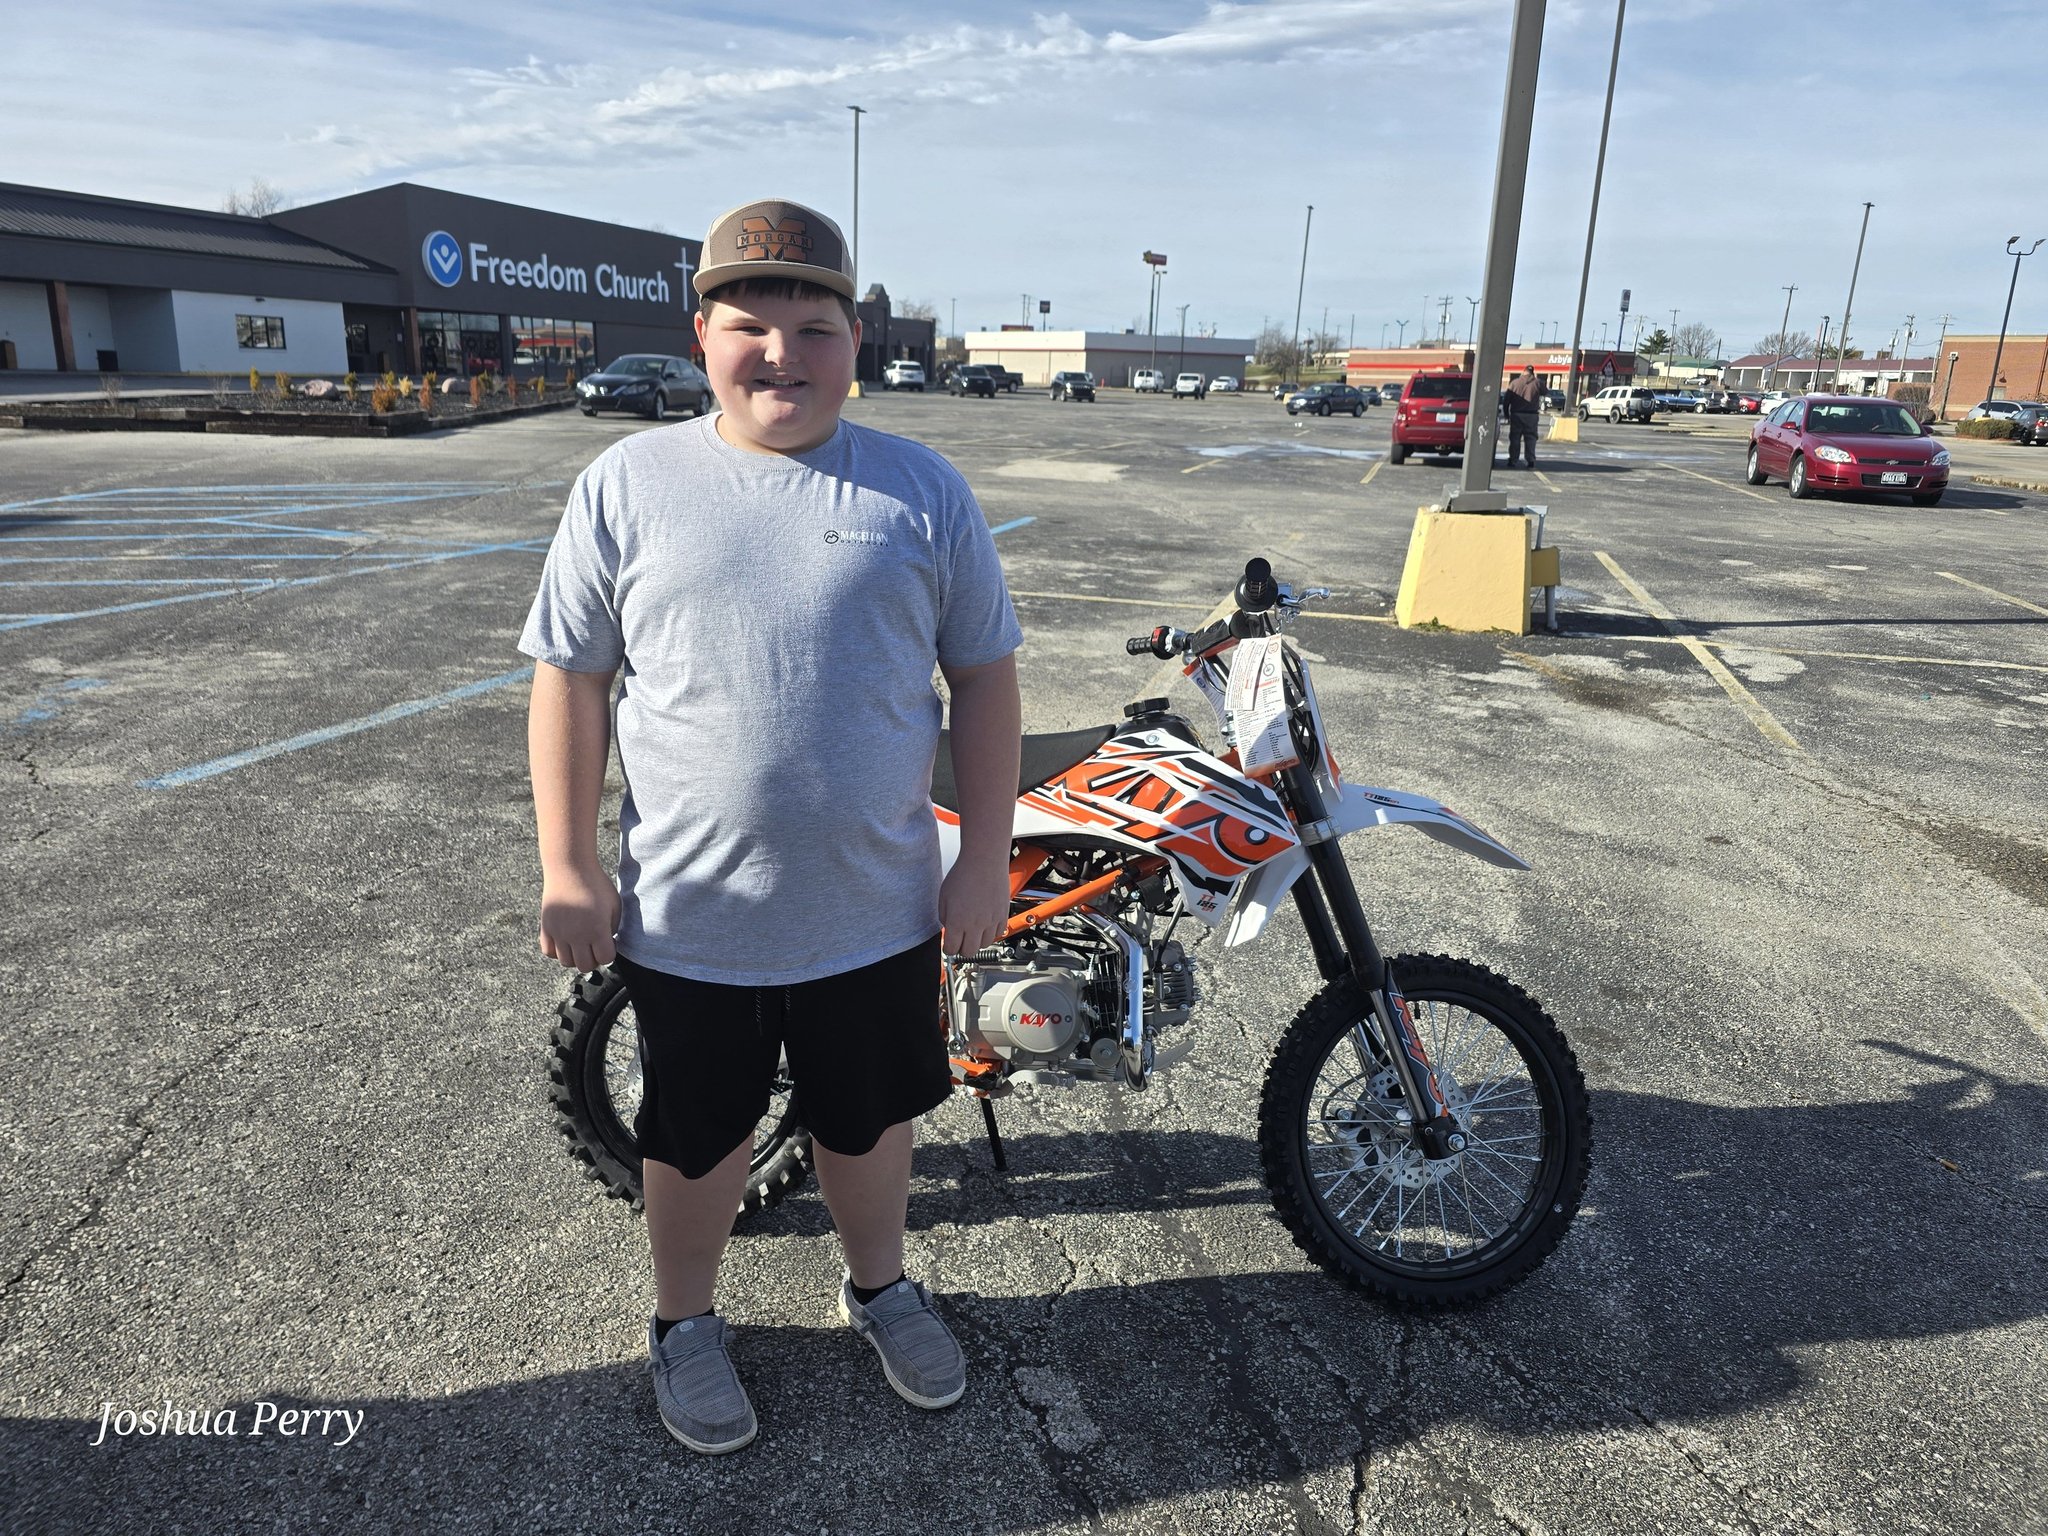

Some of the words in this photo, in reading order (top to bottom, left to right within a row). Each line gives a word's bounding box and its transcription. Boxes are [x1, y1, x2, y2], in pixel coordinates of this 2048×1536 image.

[740, 233, 810, 248] MORGAN
[468, 242, 588, 293] Freedom
[595, 263, 670, 303] Church
[1020, 1009, 1062, 1028] KAYO
